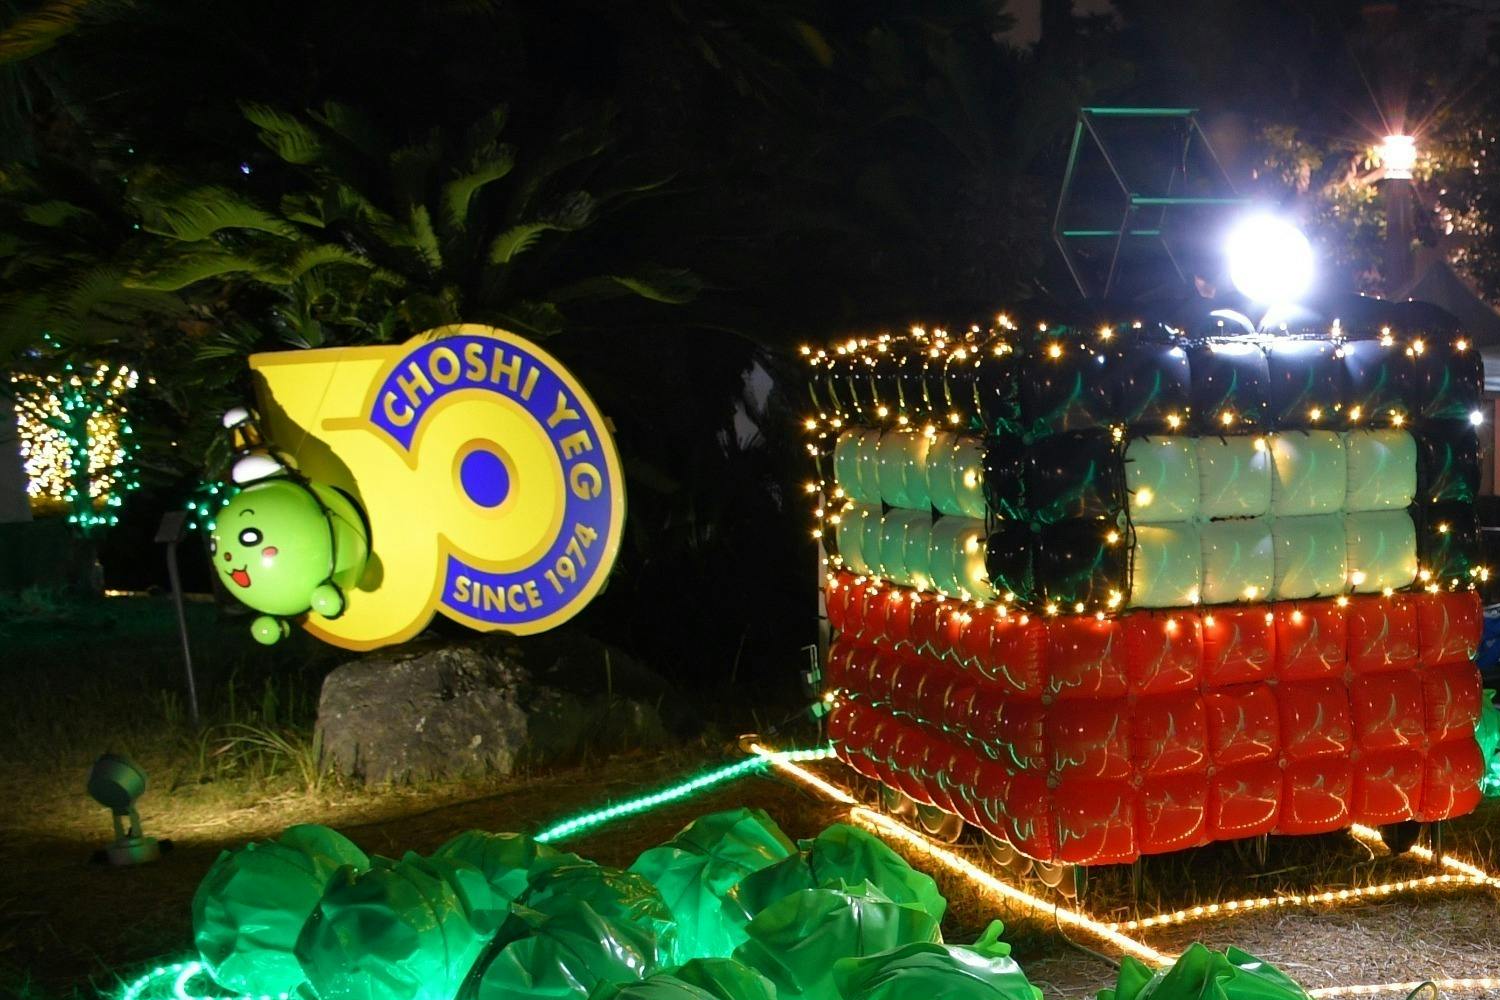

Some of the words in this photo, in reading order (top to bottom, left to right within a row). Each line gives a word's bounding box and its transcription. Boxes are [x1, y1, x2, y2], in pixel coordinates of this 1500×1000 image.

[383, 342, 540, 428] CHOSHI
[547, 391, 602, 501] YEG
[453, 575, 542, 613] SINCE
[543, 521, 598, 595] 1974
